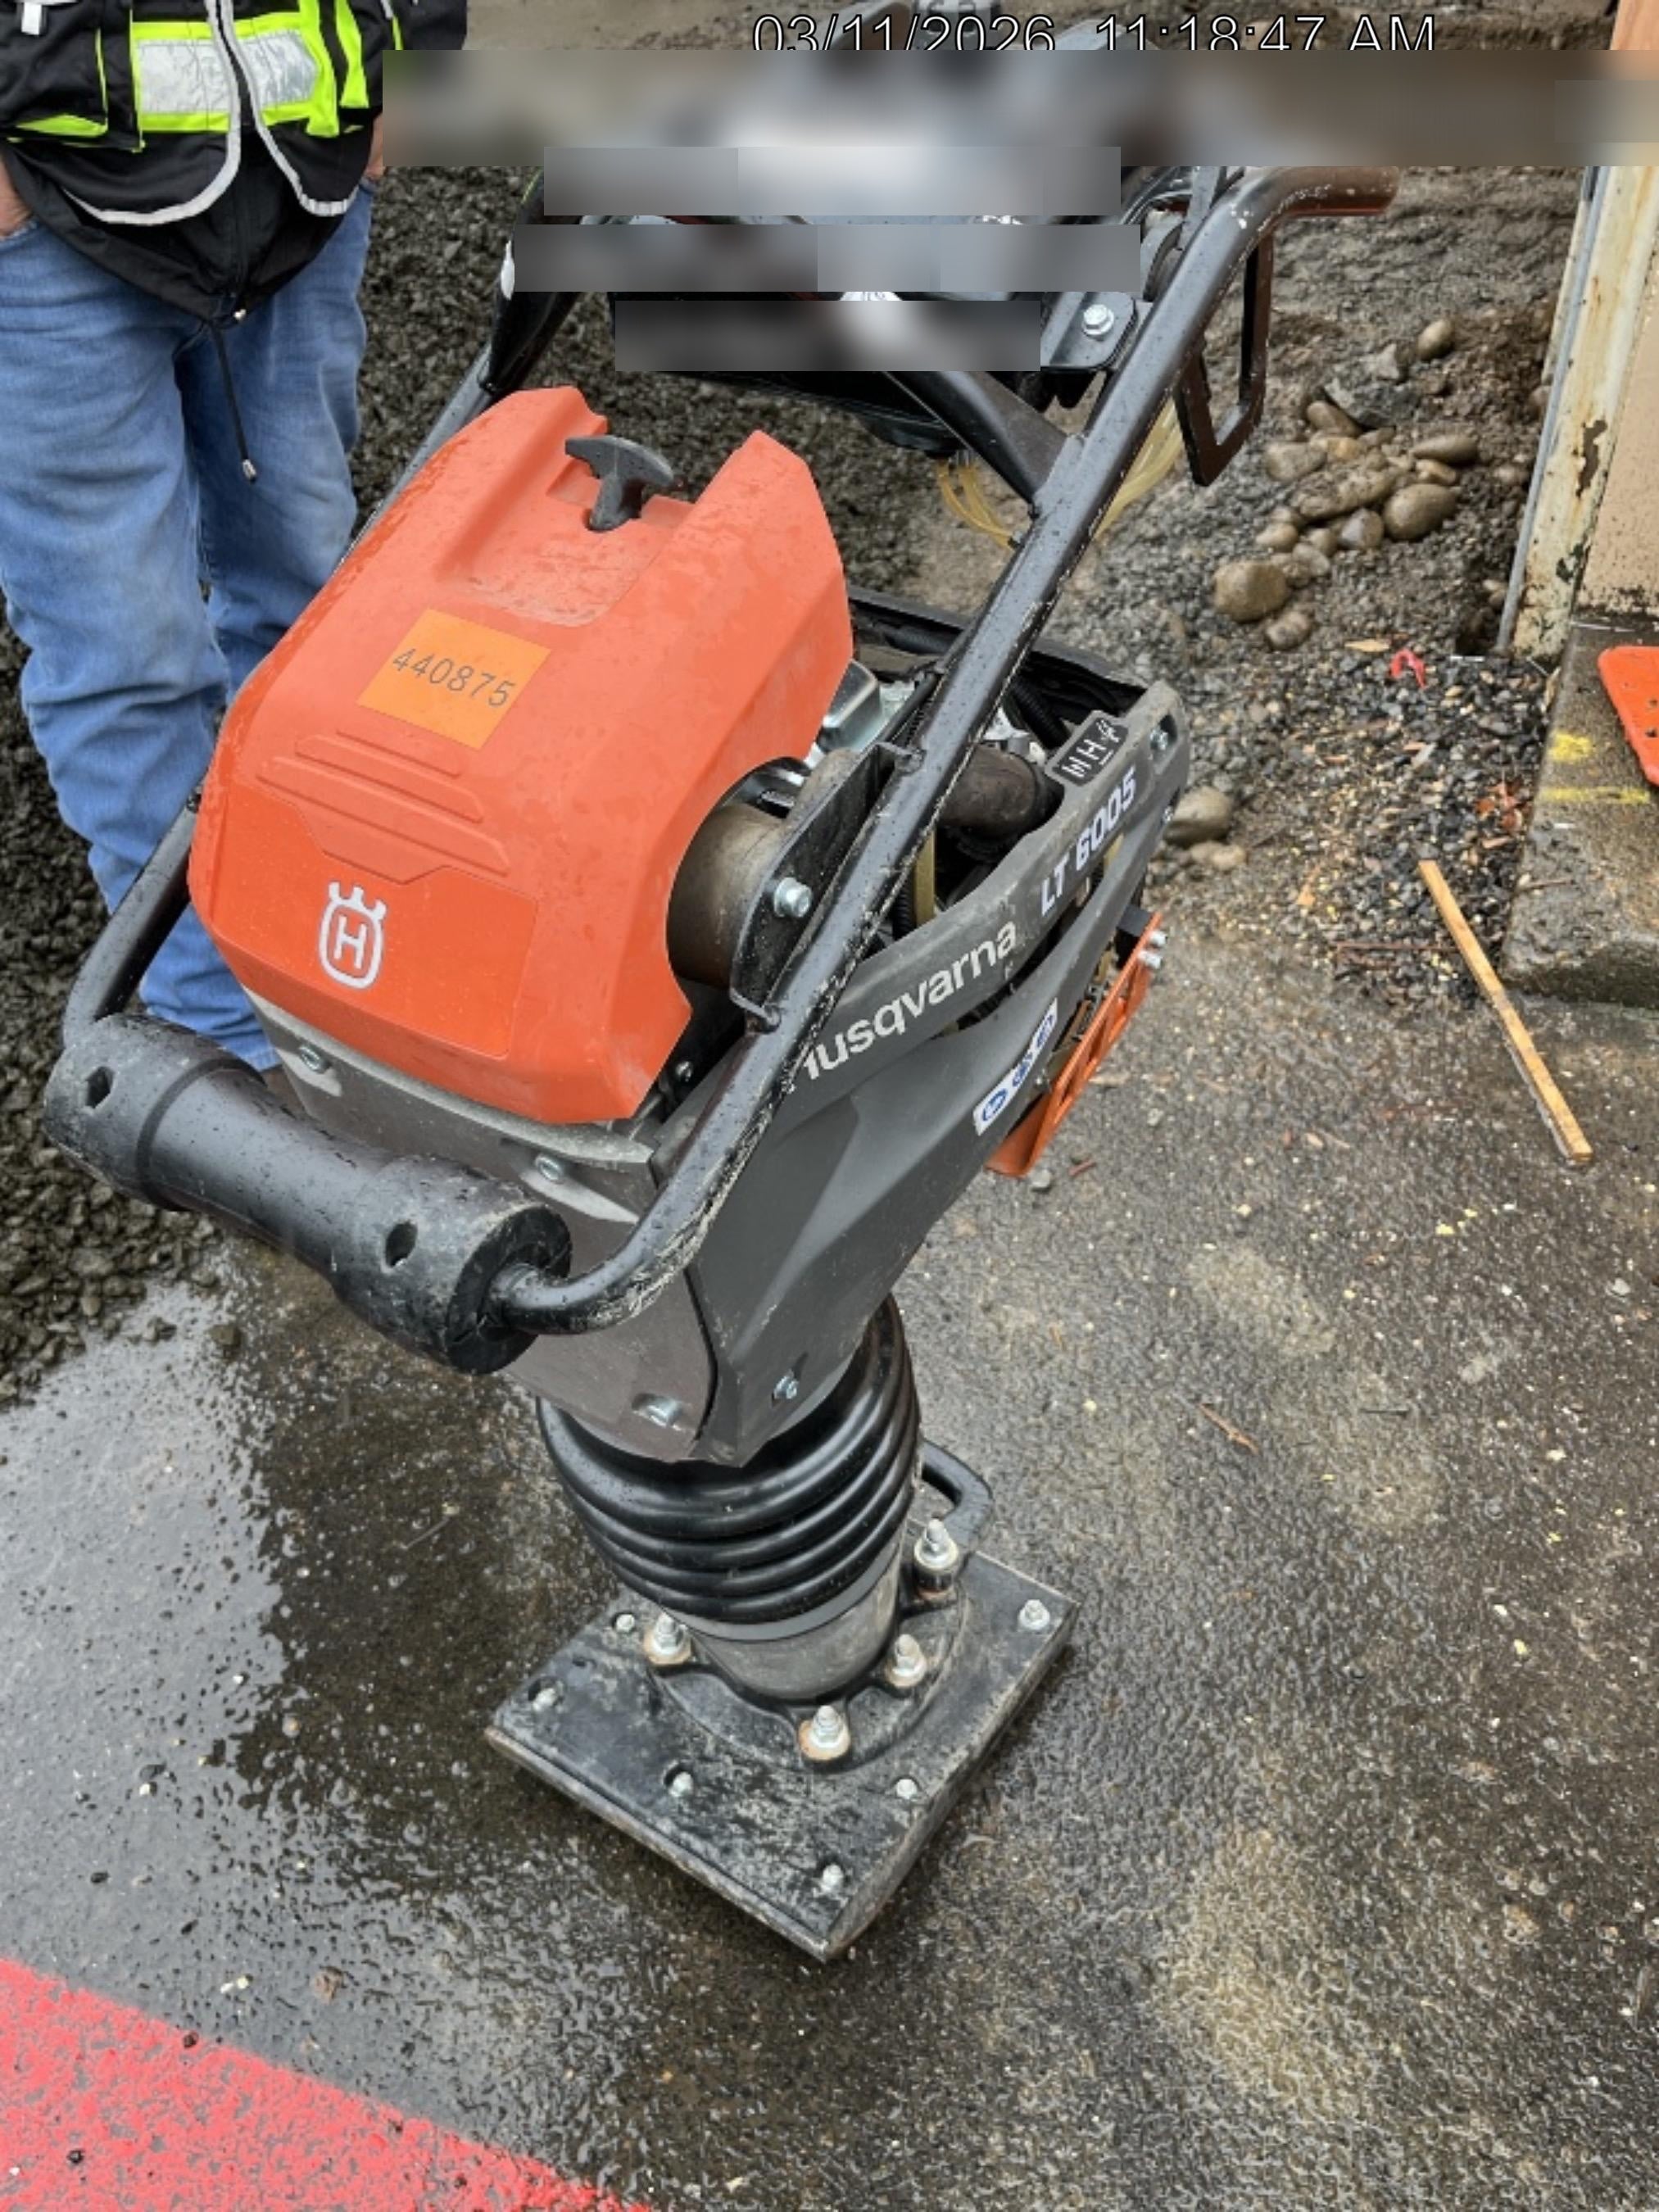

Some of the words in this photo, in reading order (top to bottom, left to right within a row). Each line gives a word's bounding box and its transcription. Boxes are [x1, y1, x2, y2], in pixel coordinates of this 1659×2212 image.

[392, 648, 516, 707] 440875
[1041, 850, 1070, 918] LT
[1076, 764, 1137, 871] 6005
